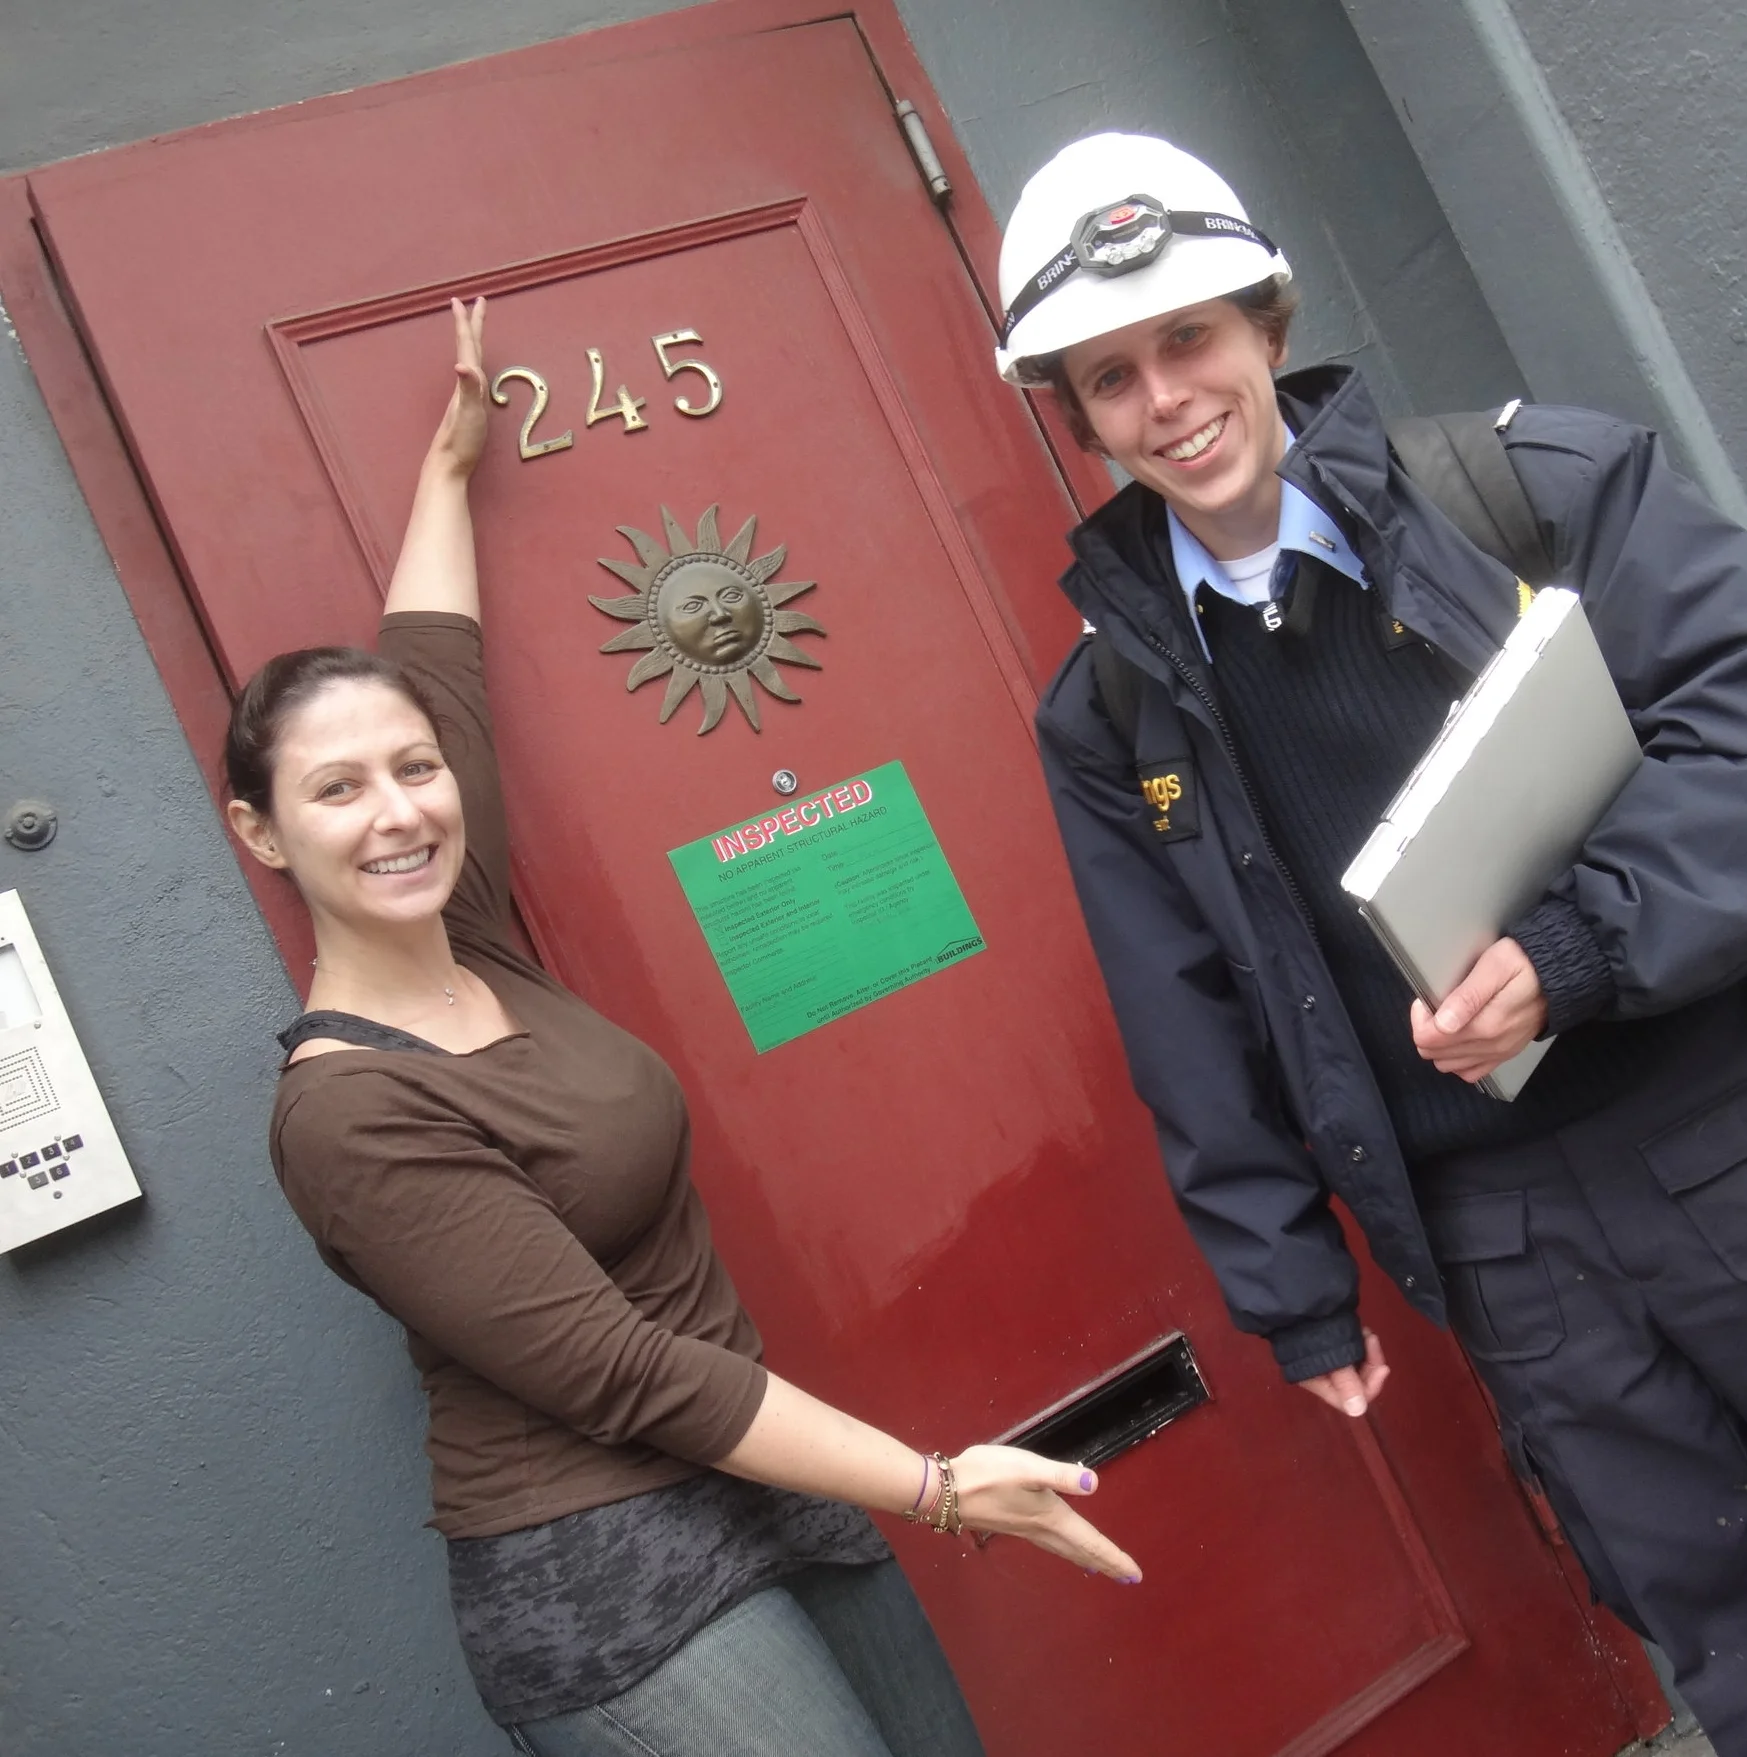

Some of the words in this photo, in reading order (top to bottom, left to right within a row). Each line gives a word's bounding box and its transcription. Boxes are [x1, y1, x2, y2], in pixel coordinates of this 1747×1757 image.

[491, 328, 723, 462] 245
[710, 777, 876, 864] INSPECTED
[717, 868, 734, 882] NO
[734, 847, 785, 875] APPARENT
[786, 821, 848, 854] STRUCTURAL
[849, 805, 888, 828] HAZARD
[724, 914, 755, 933] Inspected
[755, 903, 781, 919] Exterior
[780, 897, 797, 908] Only
[728, 924, 760, 943] Inspected
[759, 913, 785, 929] Exterior
[785, 908, 798, 918] and
[797, 898, 821, 913] Interior
[936, 936, 983, 963] BUILDINGS
